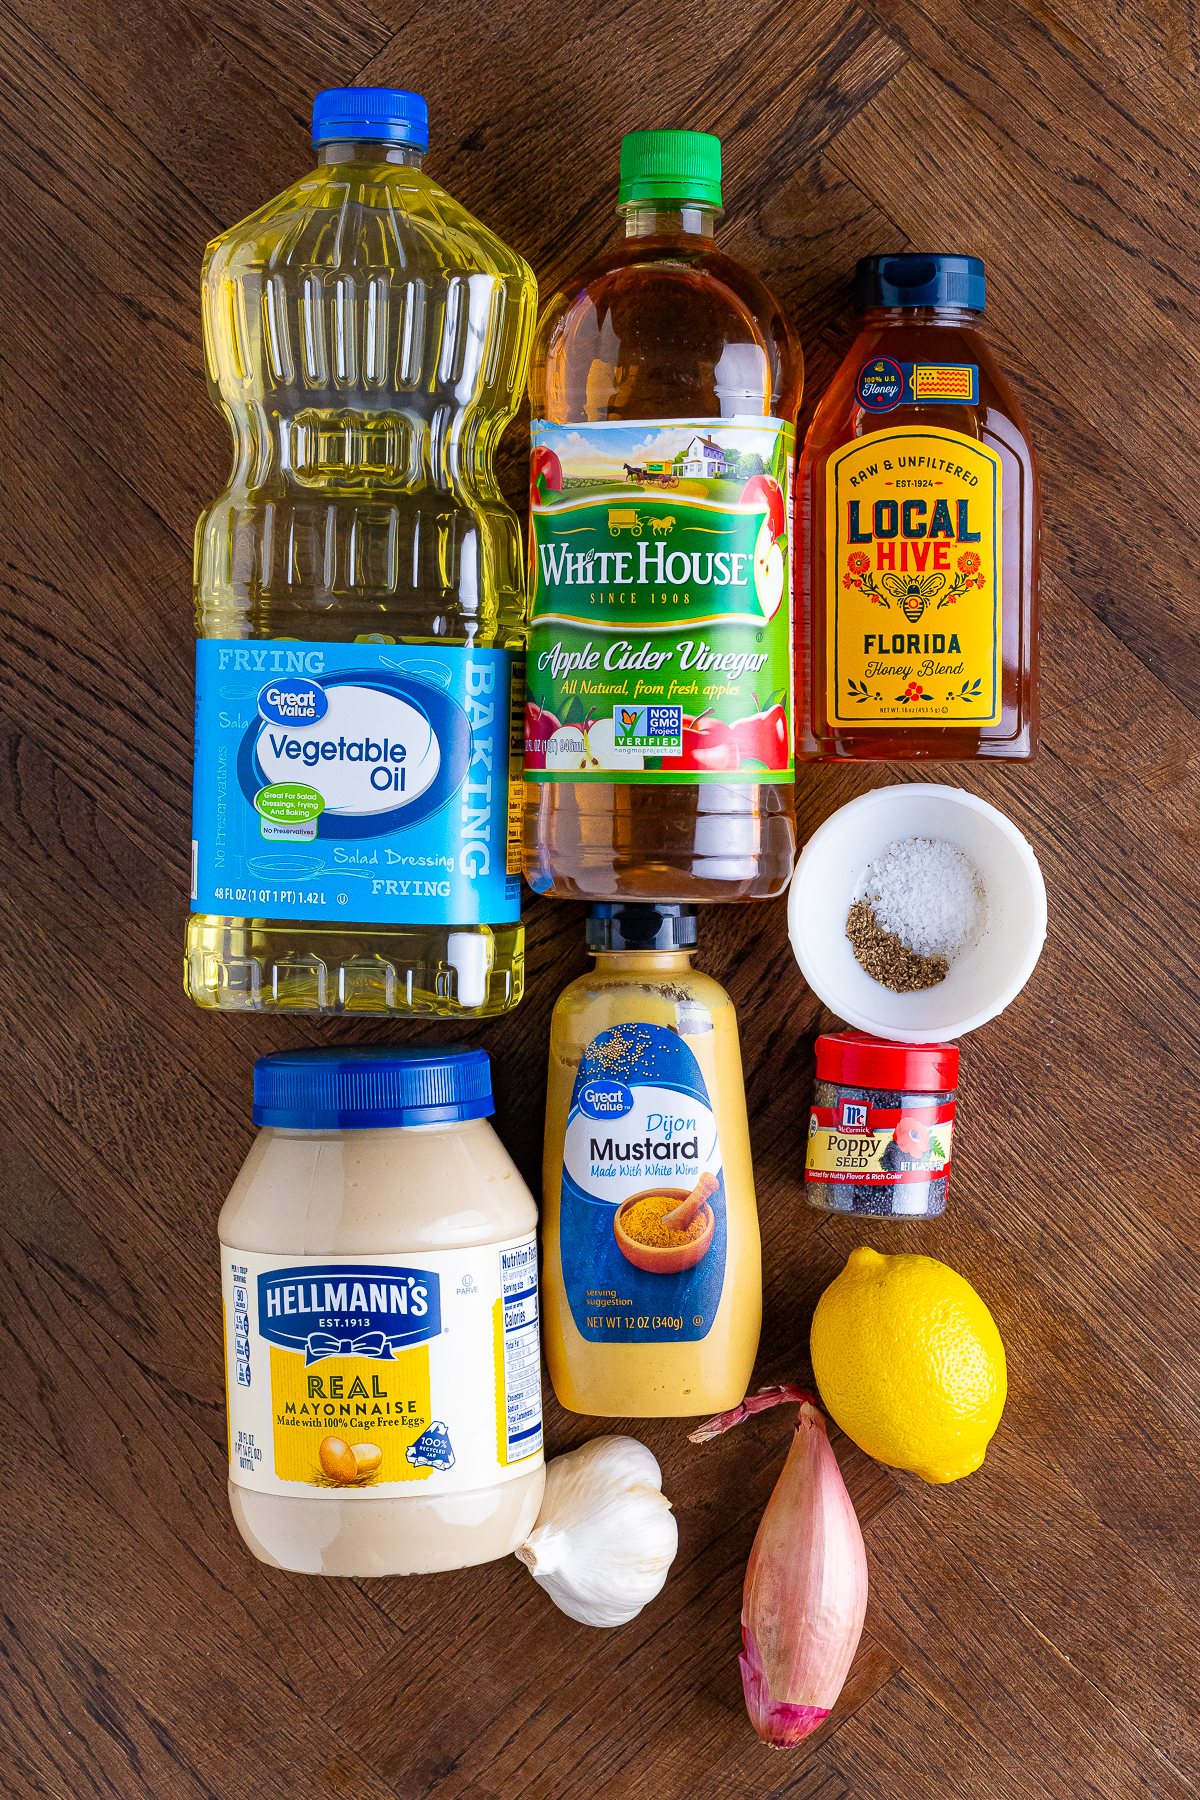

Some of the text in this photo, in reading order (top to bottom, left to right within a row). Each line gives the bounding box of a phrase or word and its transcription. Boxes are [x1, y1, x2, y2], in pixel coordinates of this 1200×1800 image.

[862, 383, 898, 397] Honey
[850, 456, 978, 487] RAW & UNFILTERED
[847, 500, 981, 544] LOCAL
[637, 542, 749, 586] HOUSE
[877, 542, 951, 572] HIVE
[590, 592, 690, 604] SINCE 1908
[864, 634, 961, 654] FLORIDA
[218, 649, 325, 673] FRYING
[538, 643, 598, 680] Apple
[602, 640, 672, 672] Cider
[675, 641, 768, 680] Vinegar
[865, 660, 964, 680] Honey Blend
[266, 688, 316, 707] Great
[560, 680, 740, 700] All Natural, from fresh apples
[278, 704, 315, 717] Value
[651, 709, 678, 718] NON
[650, 718, 679, 727] GMO
[650, 727, 678, 736] Project
[269, 734, 406, 765] Vegetable
[618, 738, 678, 746] VERIFIED
[614, 747, 681, 755] nongmoproject.org
[460, 660, 495, 880] BAKING
[370, 766, 405, 792] Oil
[285, 792, 296, 800] For
[215, 745, 228, 868] No Preservatives
[262, 800, 318, 810] Dressings, Frying
[286, 809, 309, 818] Baking
[334, 848, 454, 872] Salad Dressing
[372, 879, 451, 897] FRYING
[214, 888, 326, 904] 48 FL OZ (1 QT 1 PT) 1.42 L
[584, 1089, 623, 1104] Great
[594, 1101, 623, 1112] Value
[645, 1113, 696, 1140] Dijon
[838, 1126, 870, 1134] McCormick
[590, 1137, 698, 1161] Mustard
[827, 1135, 882, 1157] Poppy
[590, 1163, 698, 1177] Made With White Wine
[836, 1157, 868, 1168] SEED
[830, 1172, 845, 1180] Nutty
[502, 1250, 527, 1269] Nutrition
[456, 1286, 478, 1296] PARVE
[503, 1283, 517, 1293] Serving
[586, 1289, 616, 1298] serving
[266, 1276, 428, 1318] HELLMANN'S
[586, 1298, 632, 1307] suggestion
[319, 1318, 370, 1328] EST.1913
[505, 1310, 525, 1327] Calories
[586, 1316, 683, 1331] NET WT 12 OZ (340g)
[307, 1374, 388, 1399] REAL
[285, 1400, 417, 1416] MAYONNAISE
[277, 1415, 425, 1430] Made with 100% Cage Free Eggs
[419, 1446, 445, 1454] RECYCLED
[421, 1437, 447, 1448] 100%
